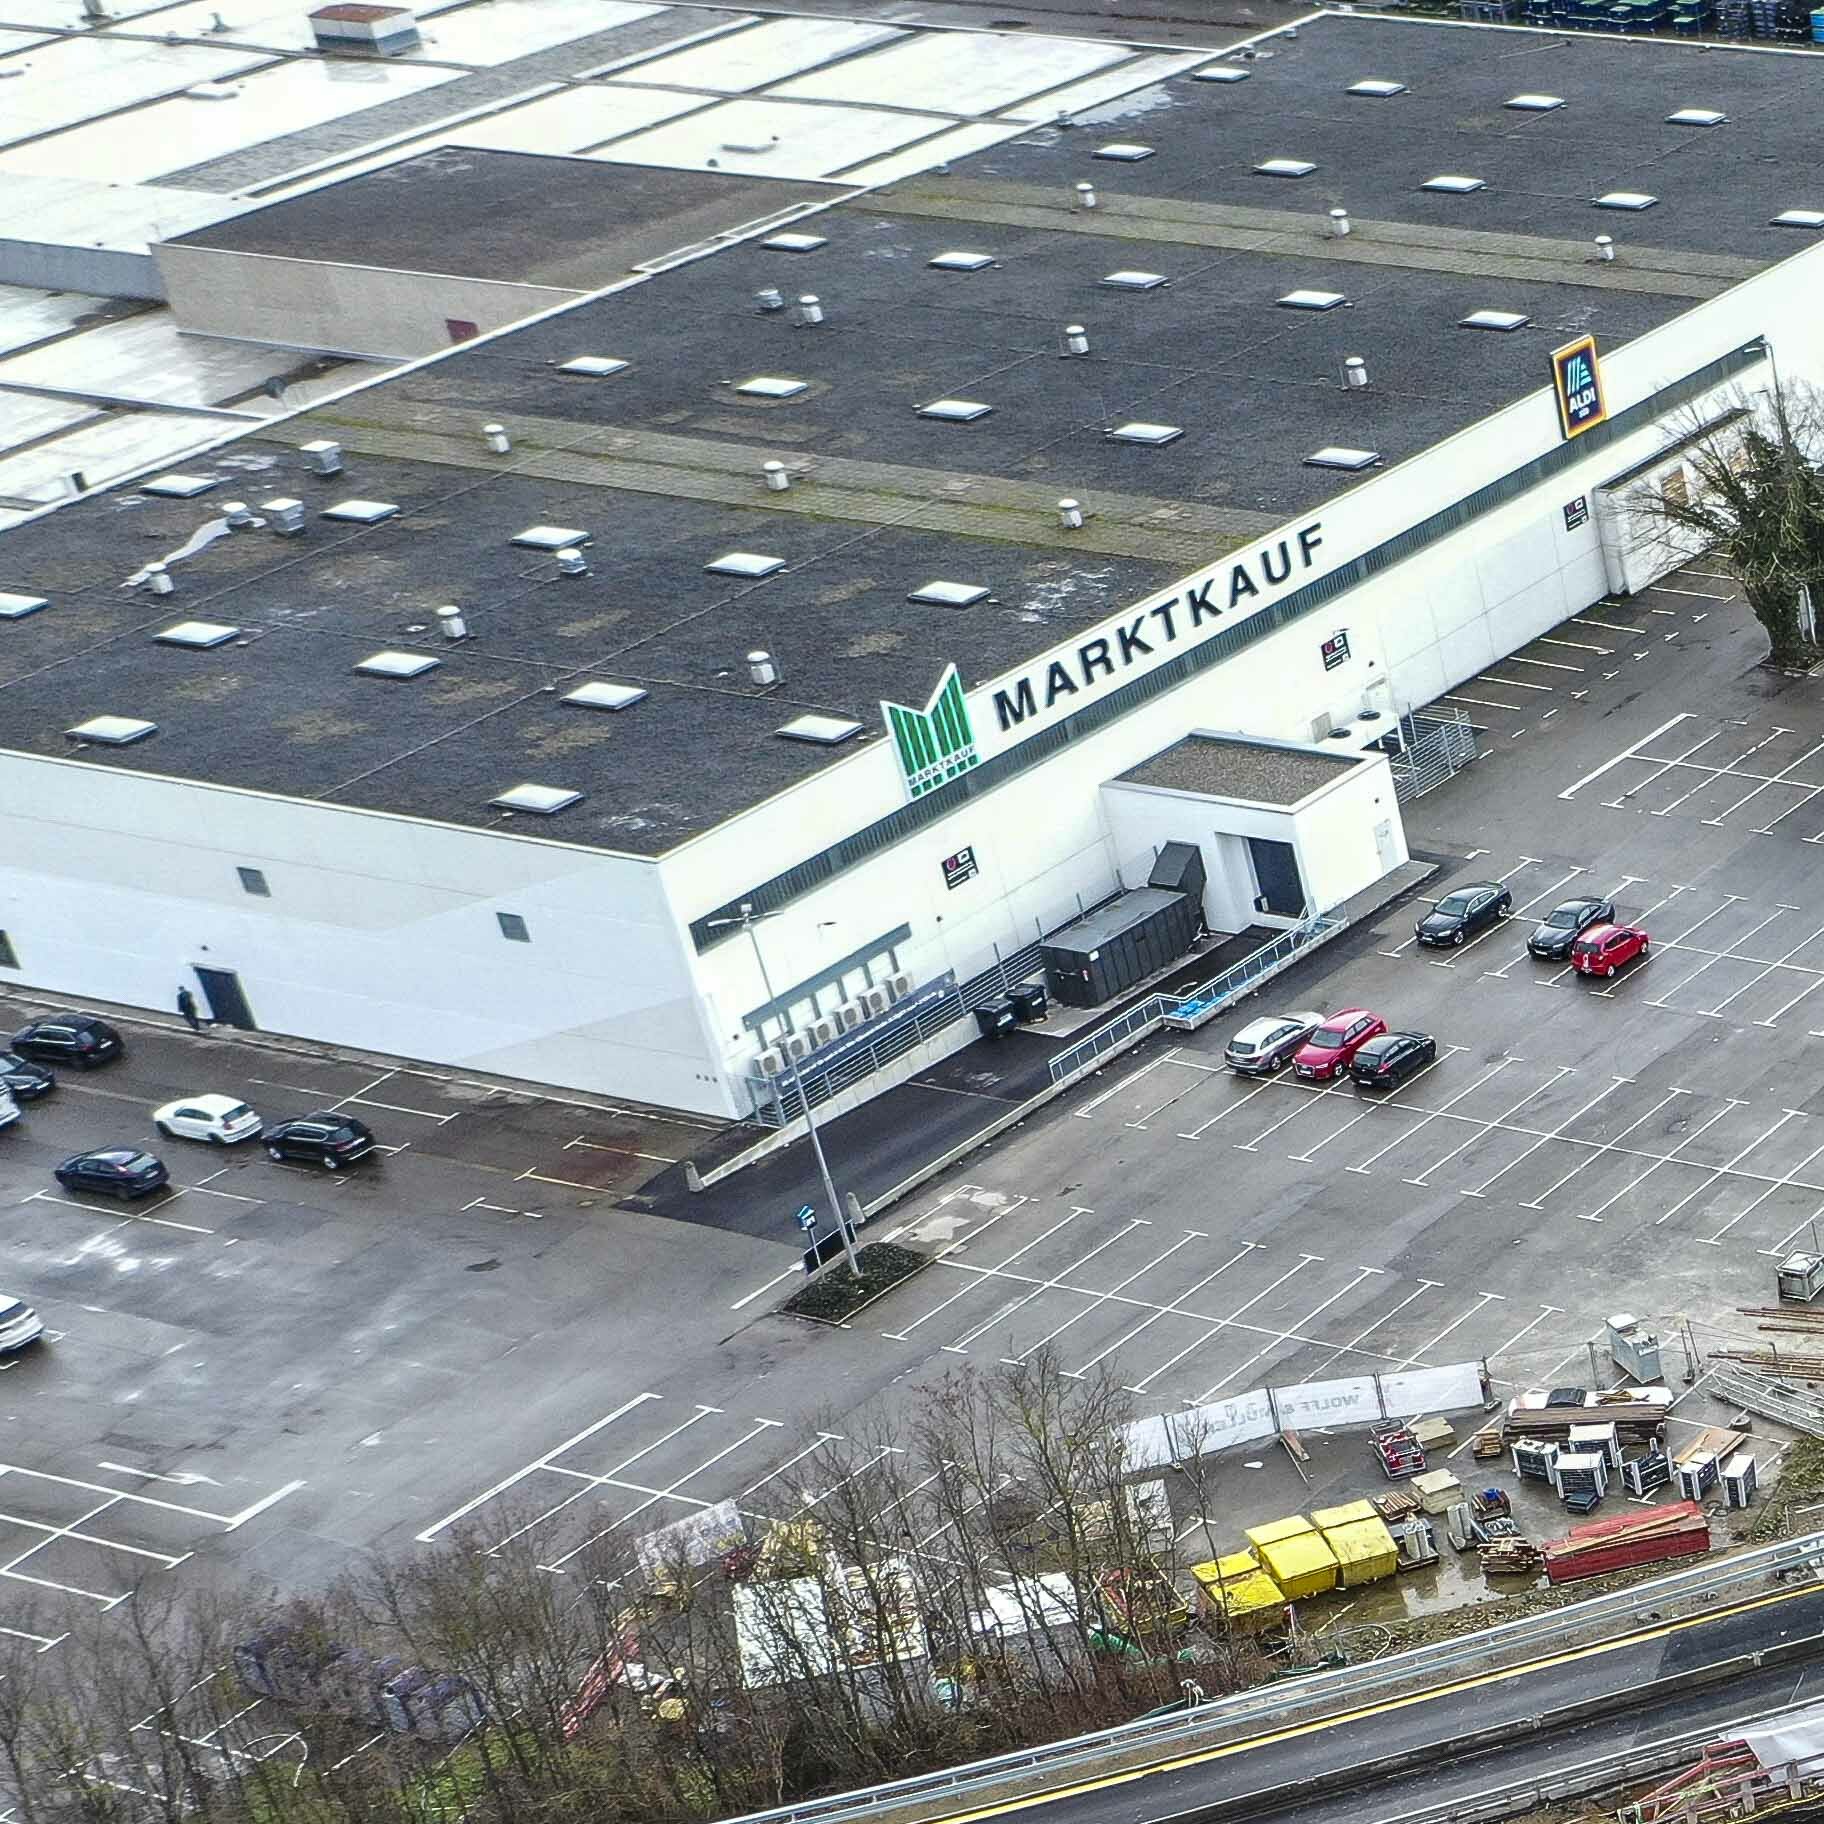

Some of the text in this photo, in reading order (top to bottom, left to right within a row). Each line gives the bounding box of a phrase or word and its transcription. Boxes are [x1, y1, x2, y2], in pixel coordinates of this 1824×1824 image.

[1569, 386, 1596, 414] ALDI
[991, 522, 1323, 732] MARKTKAUF
[907, 744, 976, 787] MARKTKAUF
